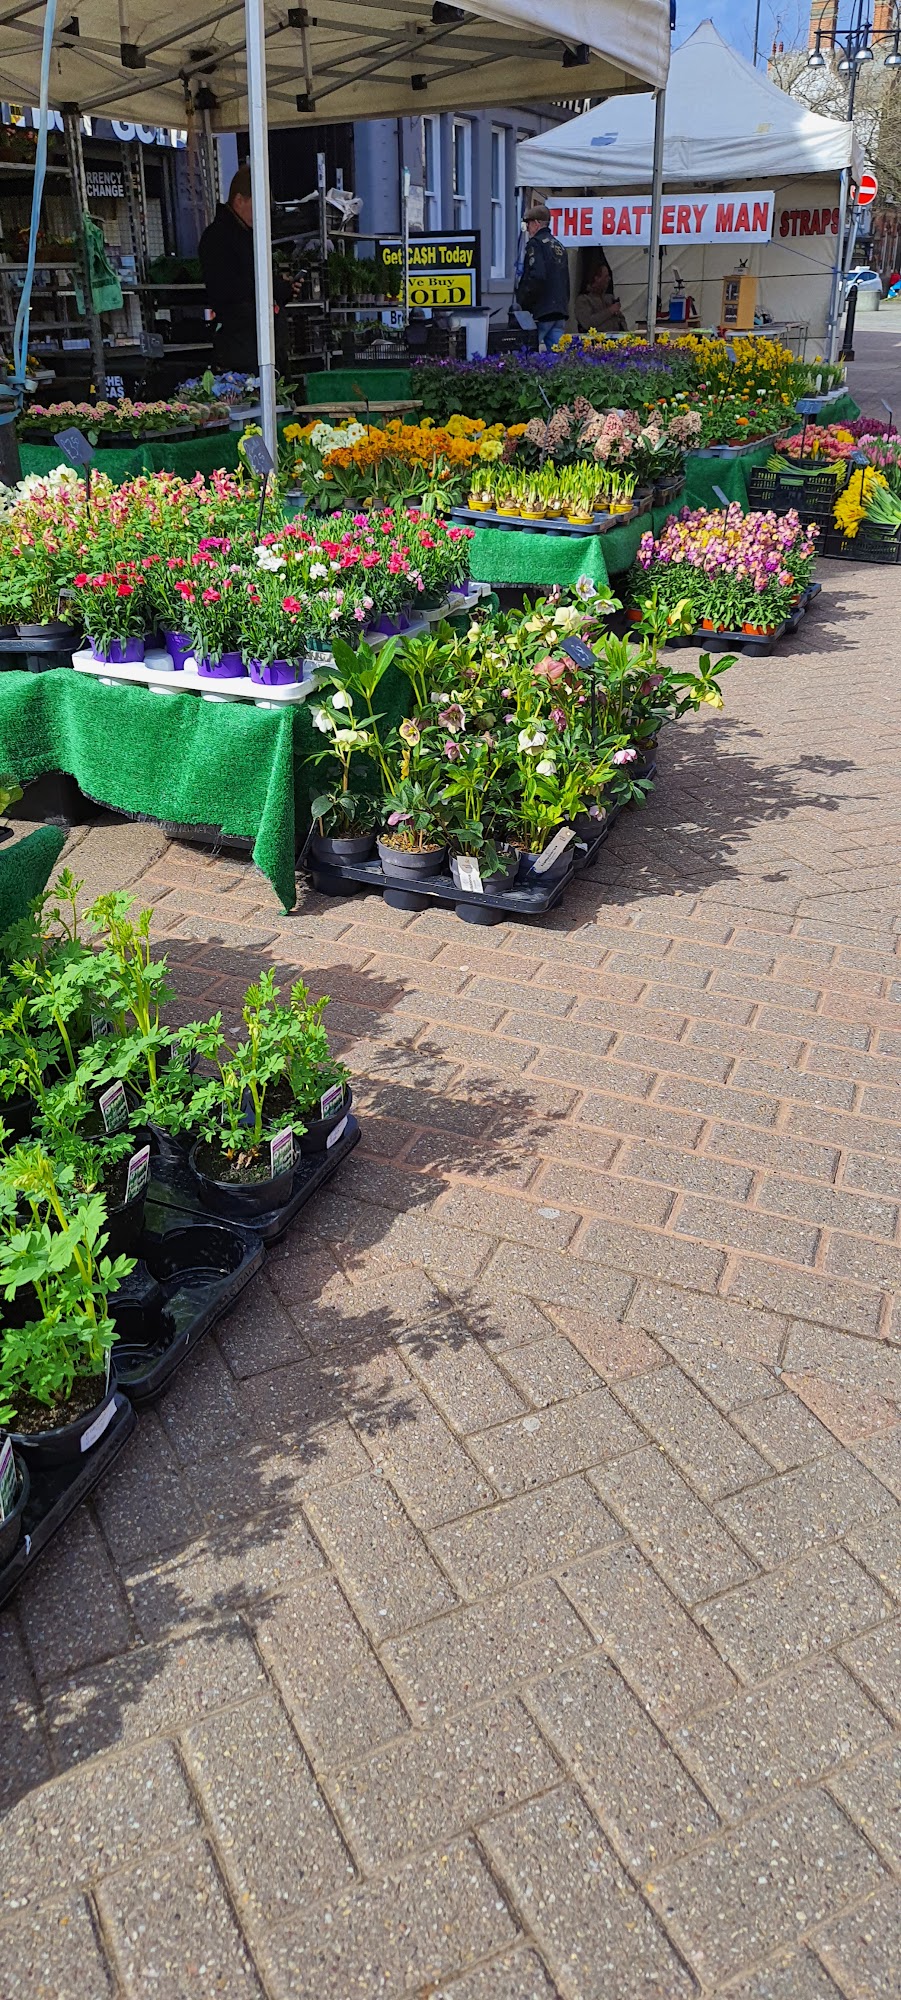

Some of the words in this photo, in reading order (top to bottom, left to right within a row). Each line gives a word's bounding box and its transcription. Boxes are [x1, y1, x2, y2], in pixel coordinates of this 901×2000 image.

[86, 171, 121, 185] RRENCY
[550, 207, 593, 237] THE
[715, 202, 769, 232] MAN
[780, 207, 839, 238] STRAPS
[382, 247, 403, 266] Get
[438, 246, 473, 267] Today
[428, 278, 454, 288] Buy
[411, 287, 466, 305] OLD
